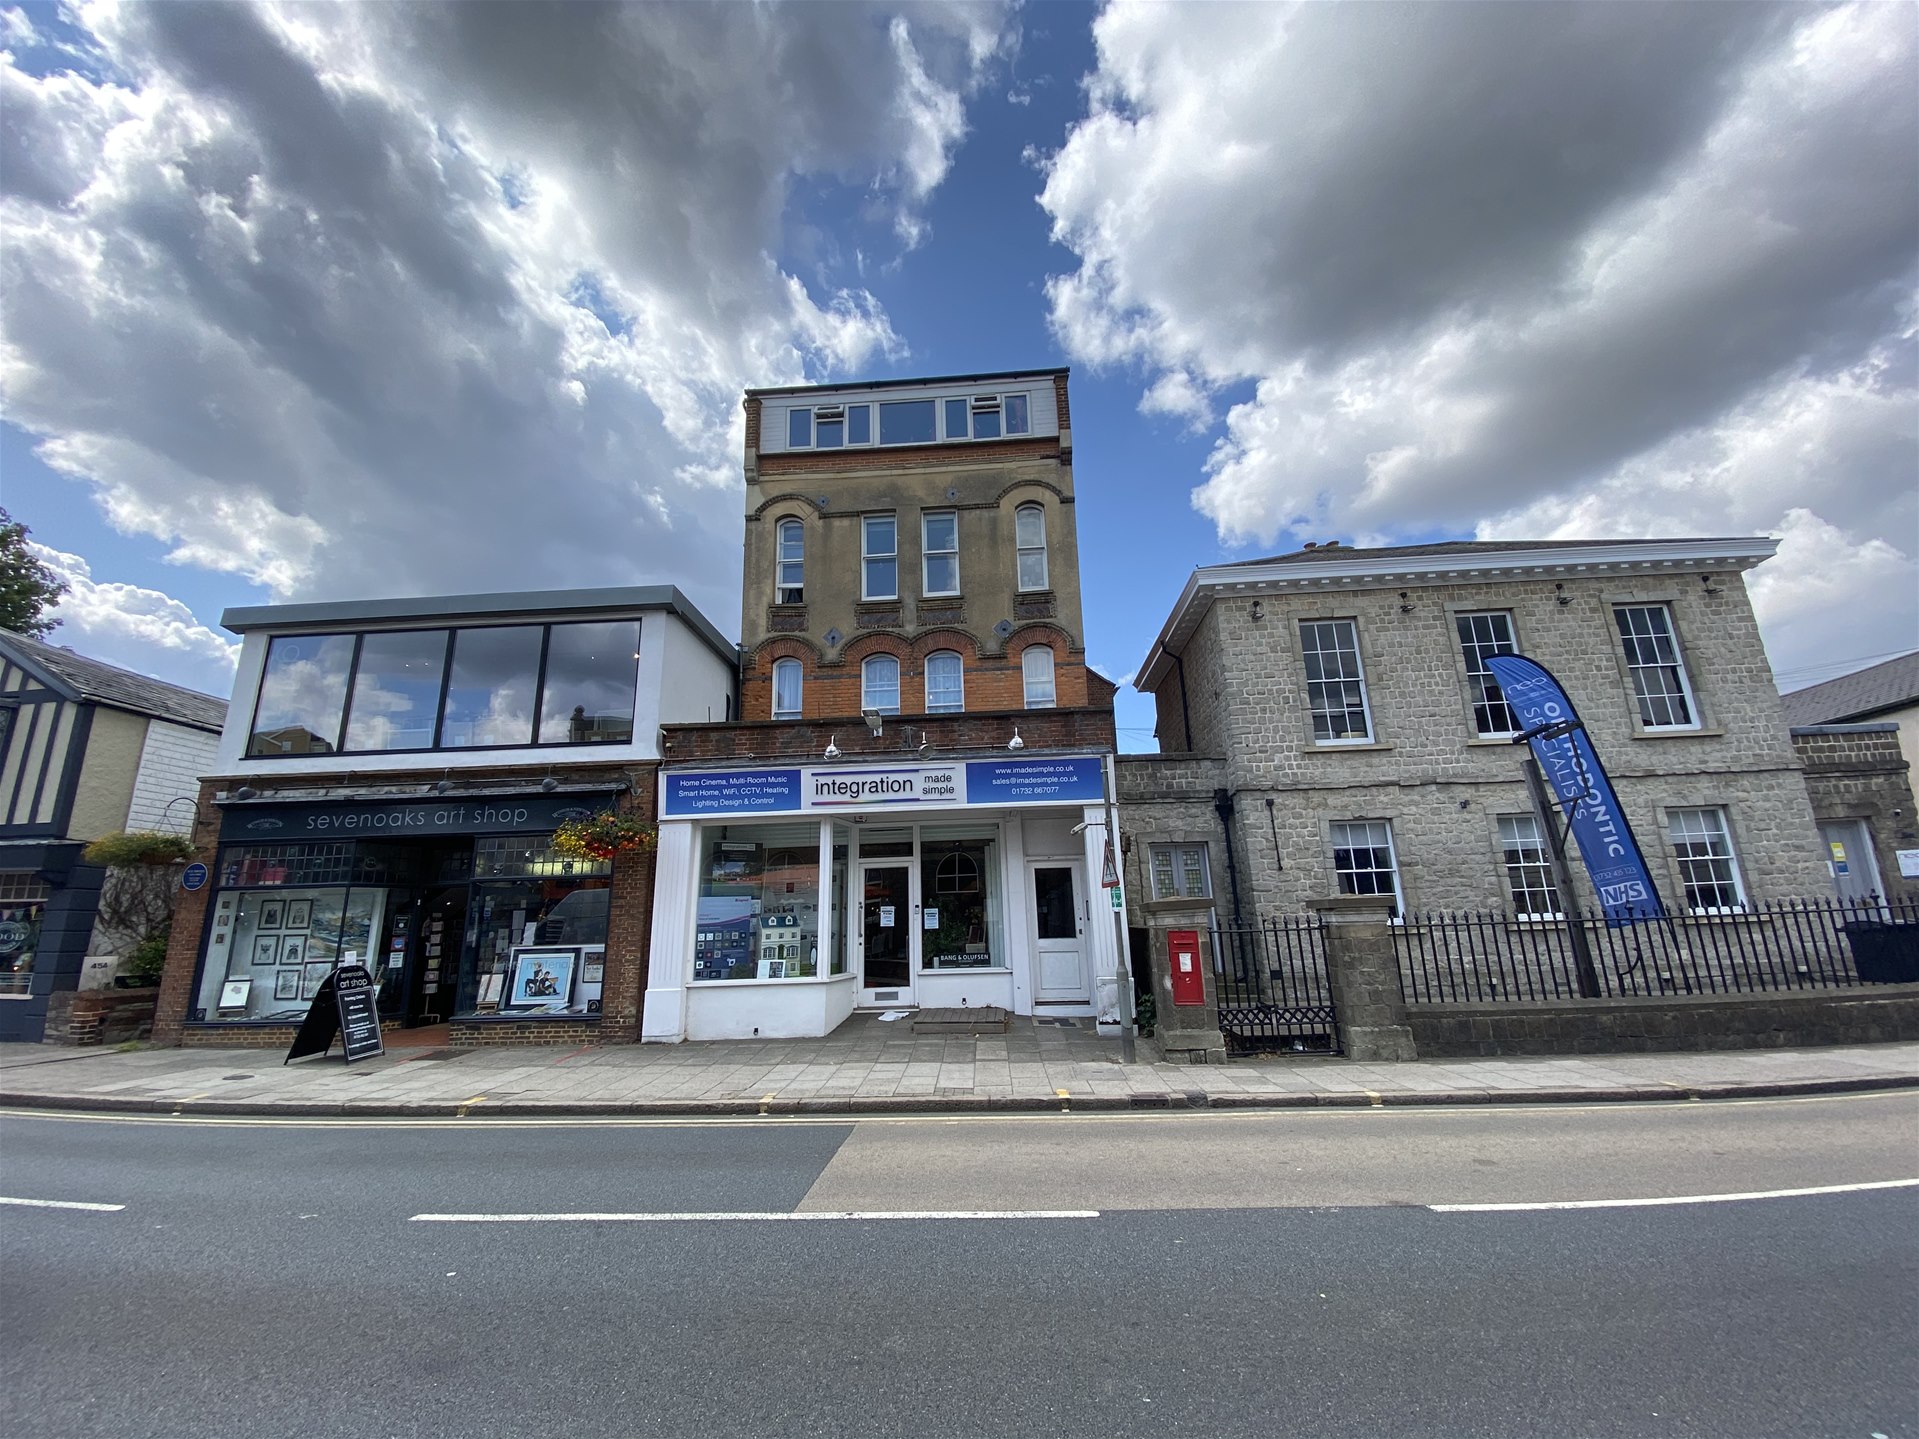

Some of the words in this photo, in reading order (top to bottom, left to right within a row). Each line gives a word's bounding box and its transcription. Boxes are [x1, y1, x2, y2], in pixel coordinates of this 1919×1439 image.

[1524, 706, 1588, 821] SPCIALISS
[995, 765, 1074, 774] www.imadesimple.co.uk
[701, 778, 728, 786] Cinema,
[729, 777, 767, 785] Multi-Room
[924, 773, 952, 783] made
[992, 775, 1079, 785] sales@imadesimple.co.uk
[700, 789, 720, 797] Home,
[722, 788, 739, 796] WiFi,
[740, 787, 762, 795] CCTV,
[763, 786, 789, 795] Heating
[815, 776, 913, 798] integration
[922, 784, 955, 796] simple
[1011, 787, 1033, 795] 01732
[1033, 786, 1060, 794] 667077
[692, 799, 719, 808] Lighting
[719, 798, 742, 807] Design
[306, 808, 425, 829] sevenoaks
[434, 807, 466, 825] art
[473, 805, 528, 826] shop
[1603, 882, 1643, 904] NHS
[340, 980, 350, 988] art
[350, 979, 368, 987] shop
